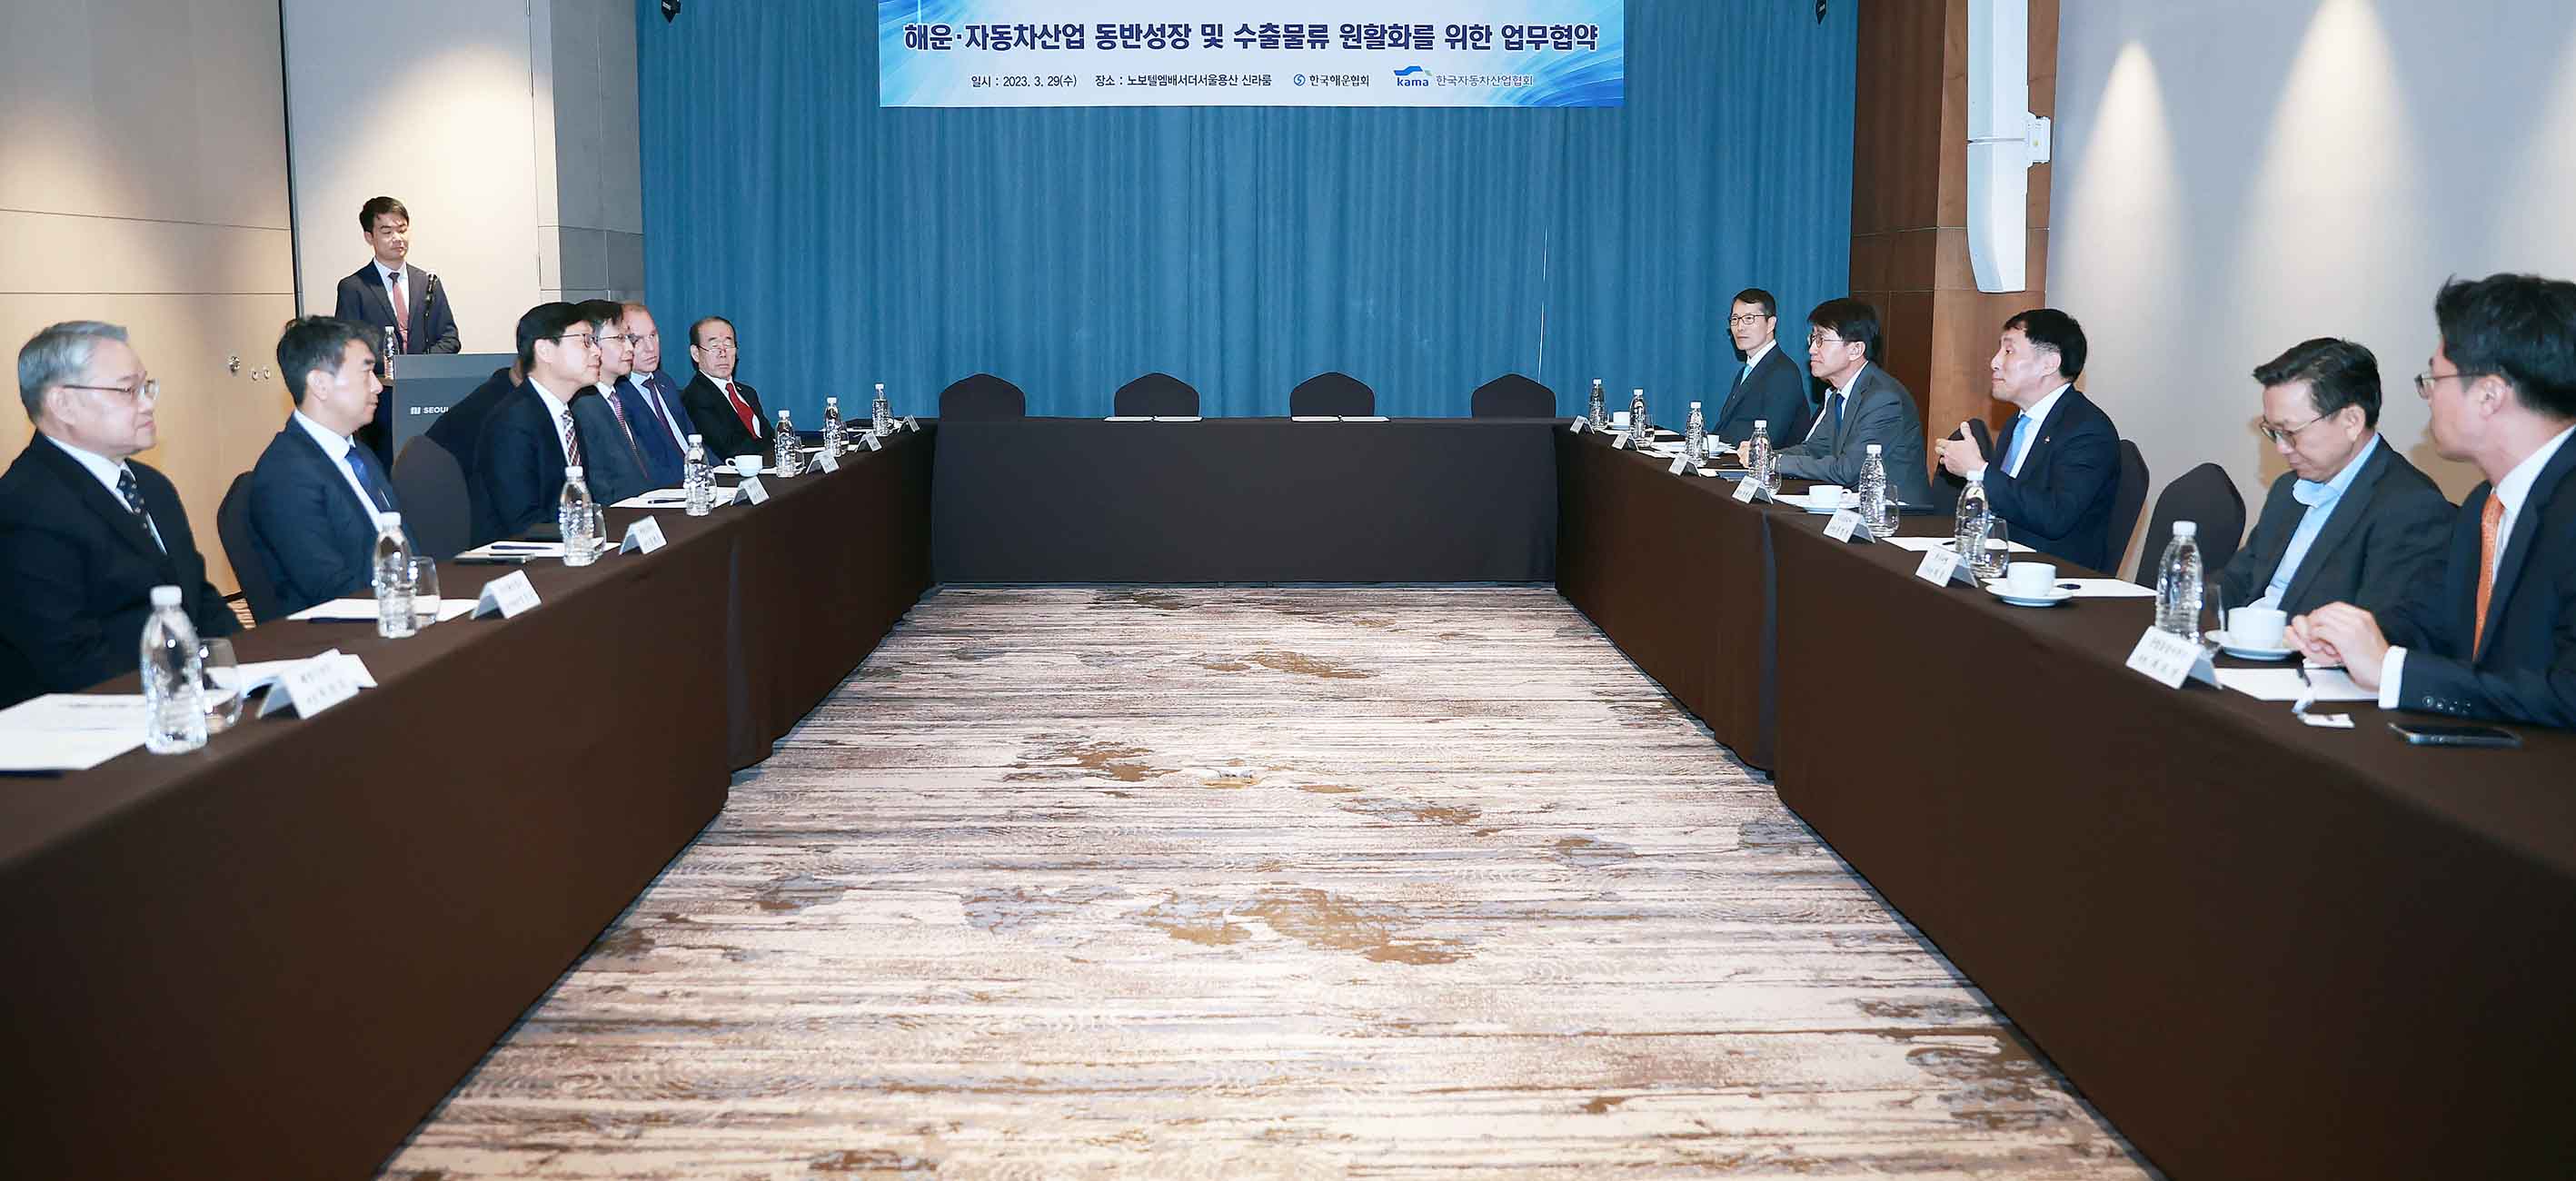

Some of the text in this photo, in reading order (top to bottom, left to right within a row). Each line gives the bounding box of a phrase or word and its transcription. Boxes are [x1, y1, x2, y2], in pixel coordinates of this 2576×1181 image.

[904, 23, 1599, 51] 해운·자동차산업 동반성장 및 수출물류 원활화를 위한 업무협약
[970, 75, 991, 88] 일시
[1003, 75, 1030, 87] 2023.
[1034, 75, 1044, 87] 3.
[1047, 74, 1078, 88] 29(수)
[1094, 74, 1116, 87] 장소
[1127, 74, 1238, 87] 노보텔엠배서더서울용산
[1241, 74, 1272, 86] 신라룸
[1397, 76, 1429, 87] kama
[1436, 74, 1534, 87] 한국자동차산업협회
